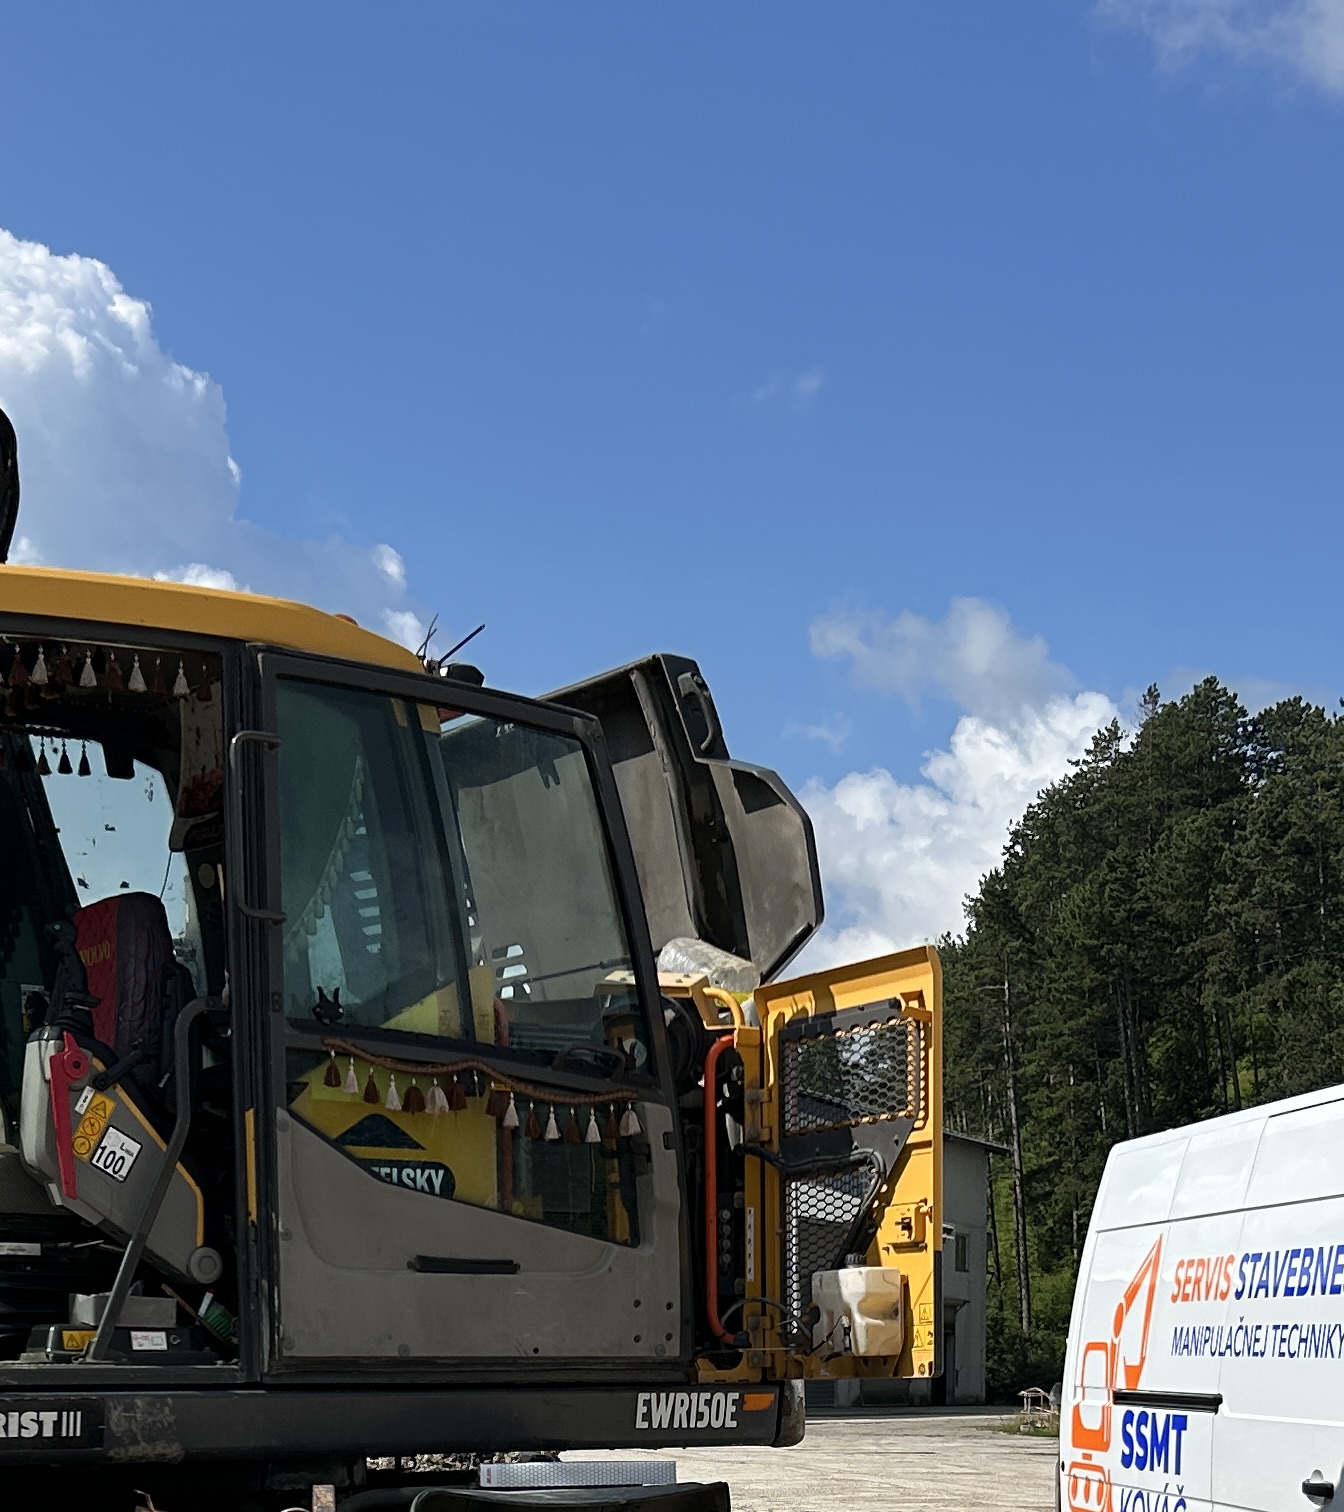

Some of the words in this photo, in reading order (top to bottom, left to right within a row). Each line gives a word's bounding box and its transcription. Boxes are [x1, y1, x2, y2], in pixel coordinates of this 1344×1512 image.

[79, 940, 111, 966] VOLVO
[96, 1145, 126, 1175] 100
[1171, 1254, 1235, 1304] SERVIS
[1171, 1316, 1269, 1358] MANIPULAČNEJ
[636, 1392, 740, 1429] EWR150E
[1121, 1409, 1188, 1475] SSMT
